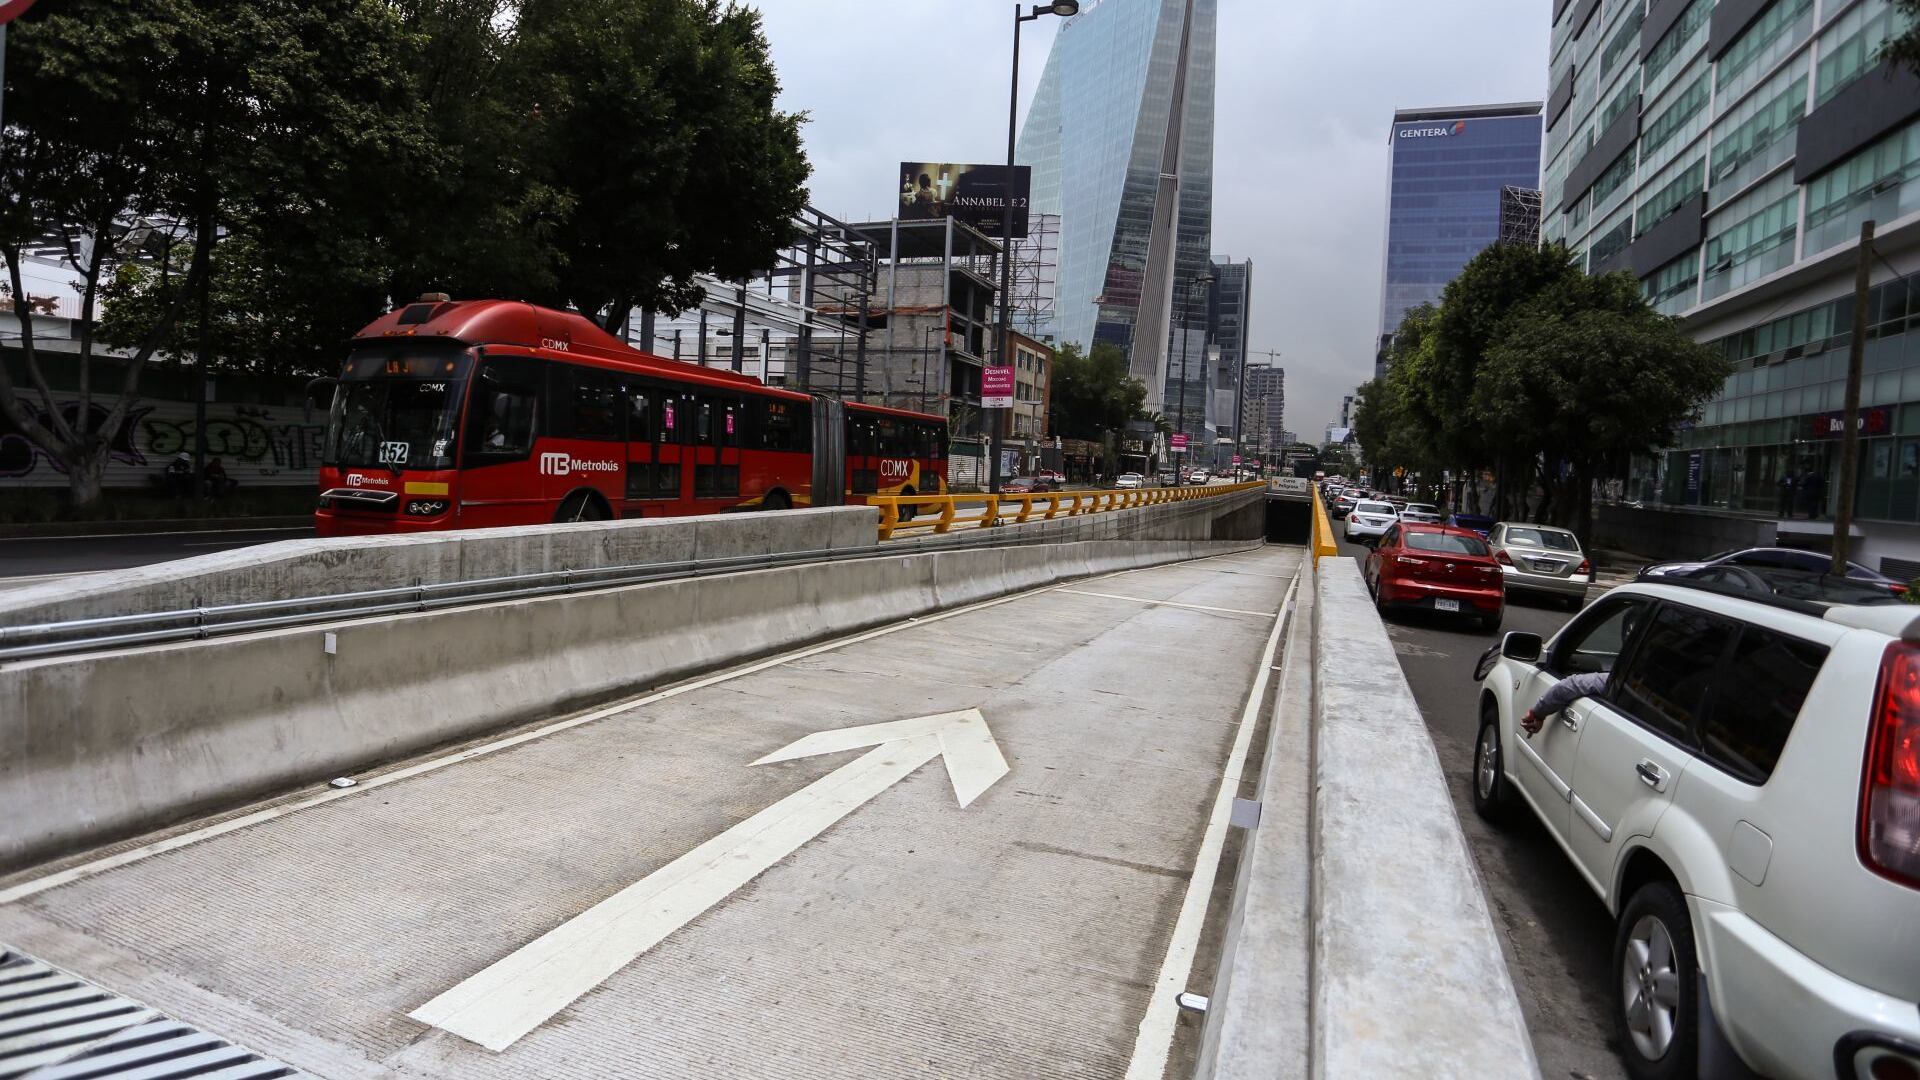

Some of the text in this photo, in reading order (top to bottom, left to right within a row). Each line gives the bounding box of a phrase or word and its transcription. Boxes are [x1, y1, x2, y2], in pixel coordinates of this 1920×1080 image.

[1400, 127, 1448, 138] GENTERA
[951, 195, 1027, 208] ANNABELE 2
[541, 338, 569, 352] CDMX
[419, 383, 446, 392] CDMX
[380, 443, 407, 461] 152
[571, 459, 619, 472] Metrobús
[880, 459, 909, 477] CDMX
